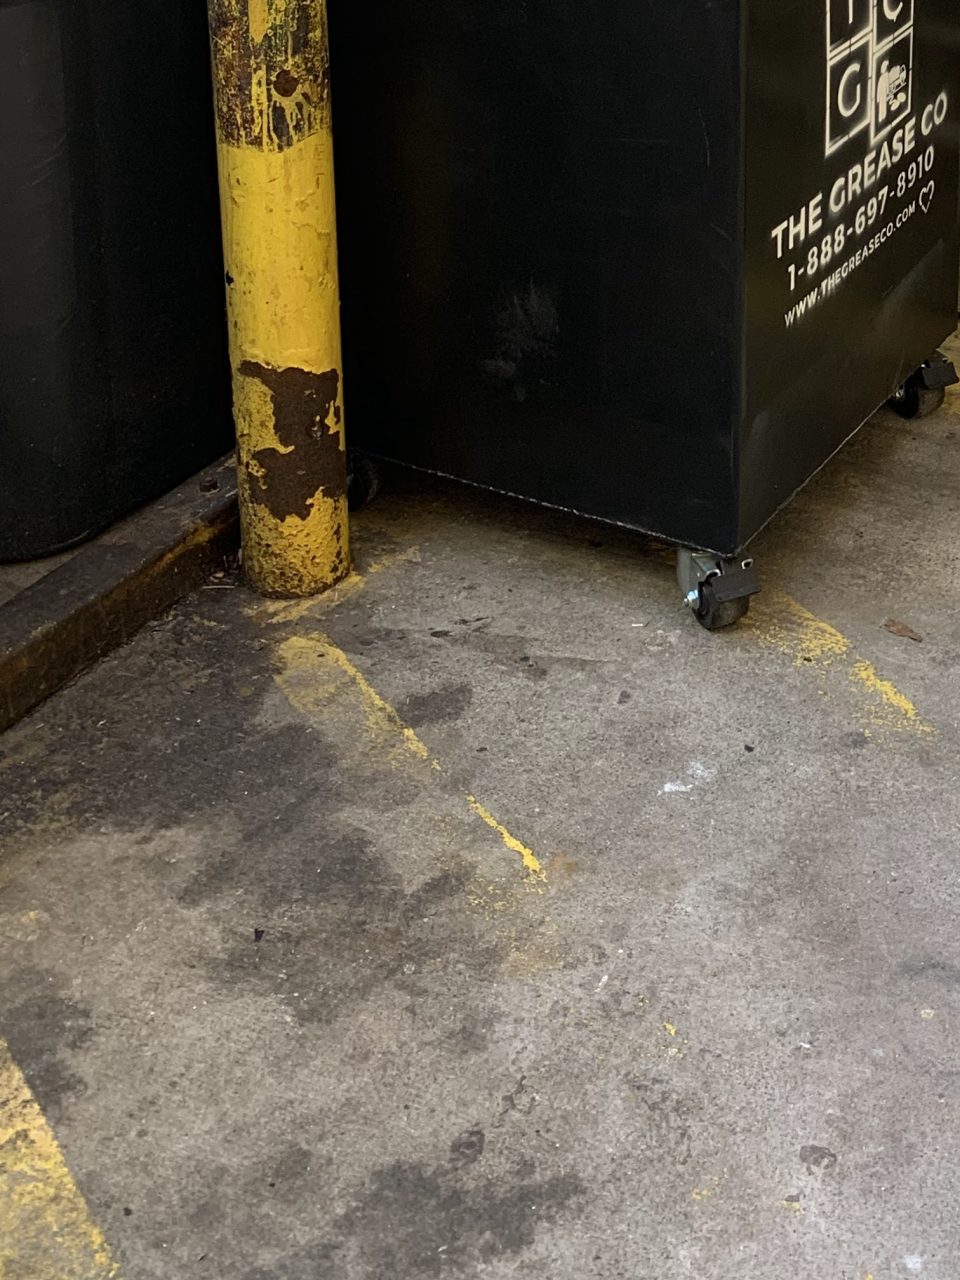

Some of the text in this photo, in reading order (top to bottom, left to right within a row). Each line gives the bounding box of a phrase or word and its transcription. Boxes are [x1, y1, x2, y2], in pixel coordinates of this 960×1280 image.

[771, 91, 948, 259] THE GREASE CO
[787, 145, 935, 291] 1-888-697-8910
[784, 200, 917, 328] WWW.THEGREASECO.COM
